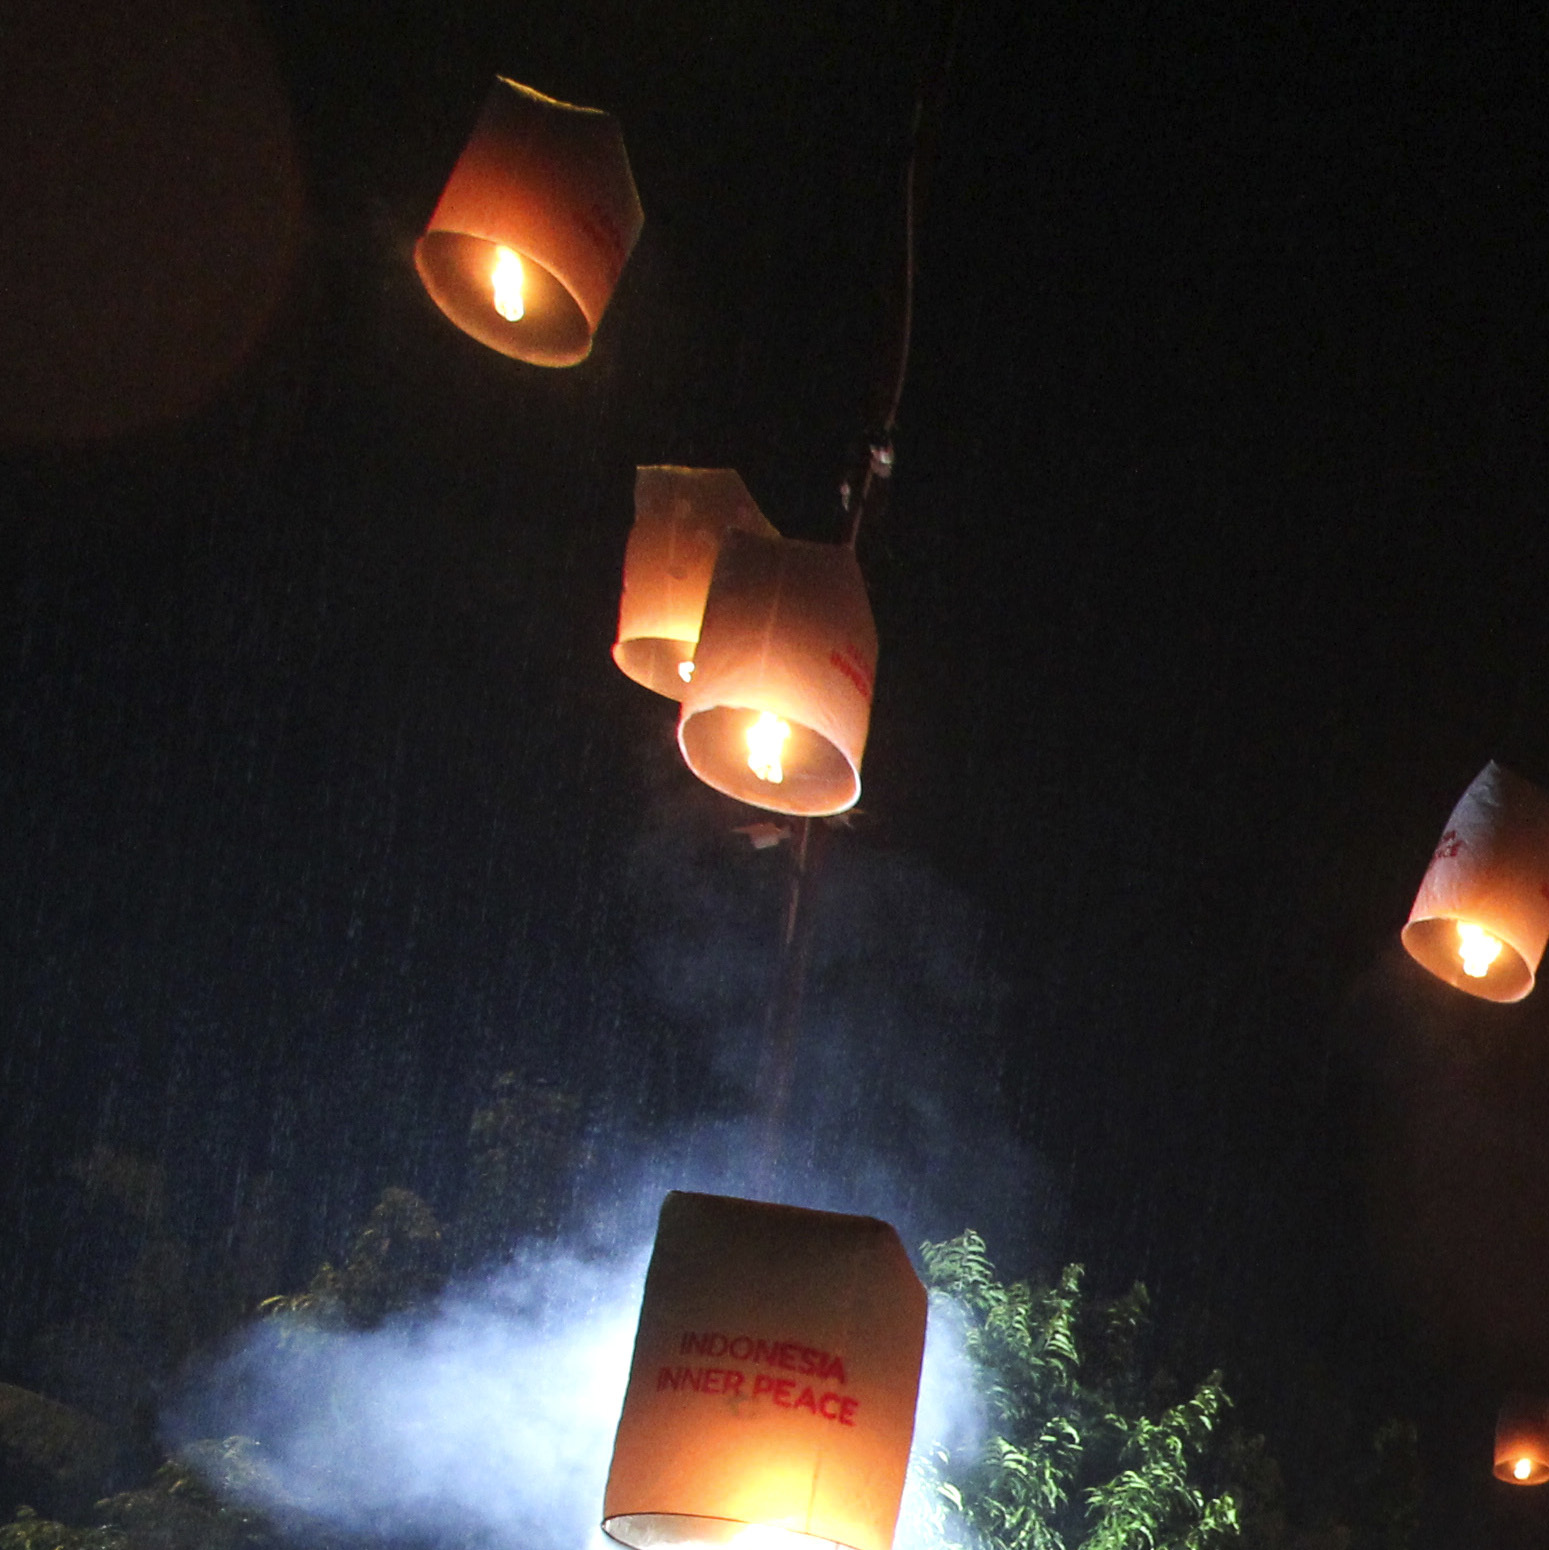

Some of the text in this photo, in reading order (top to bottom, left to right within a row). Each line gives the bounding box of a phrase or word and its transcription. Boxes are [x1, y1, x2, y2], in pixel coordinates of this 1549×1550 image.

[681, 1331, 847, 1385] INDONESIA
[656, 1367, 861, 1428] INNER PEACE
